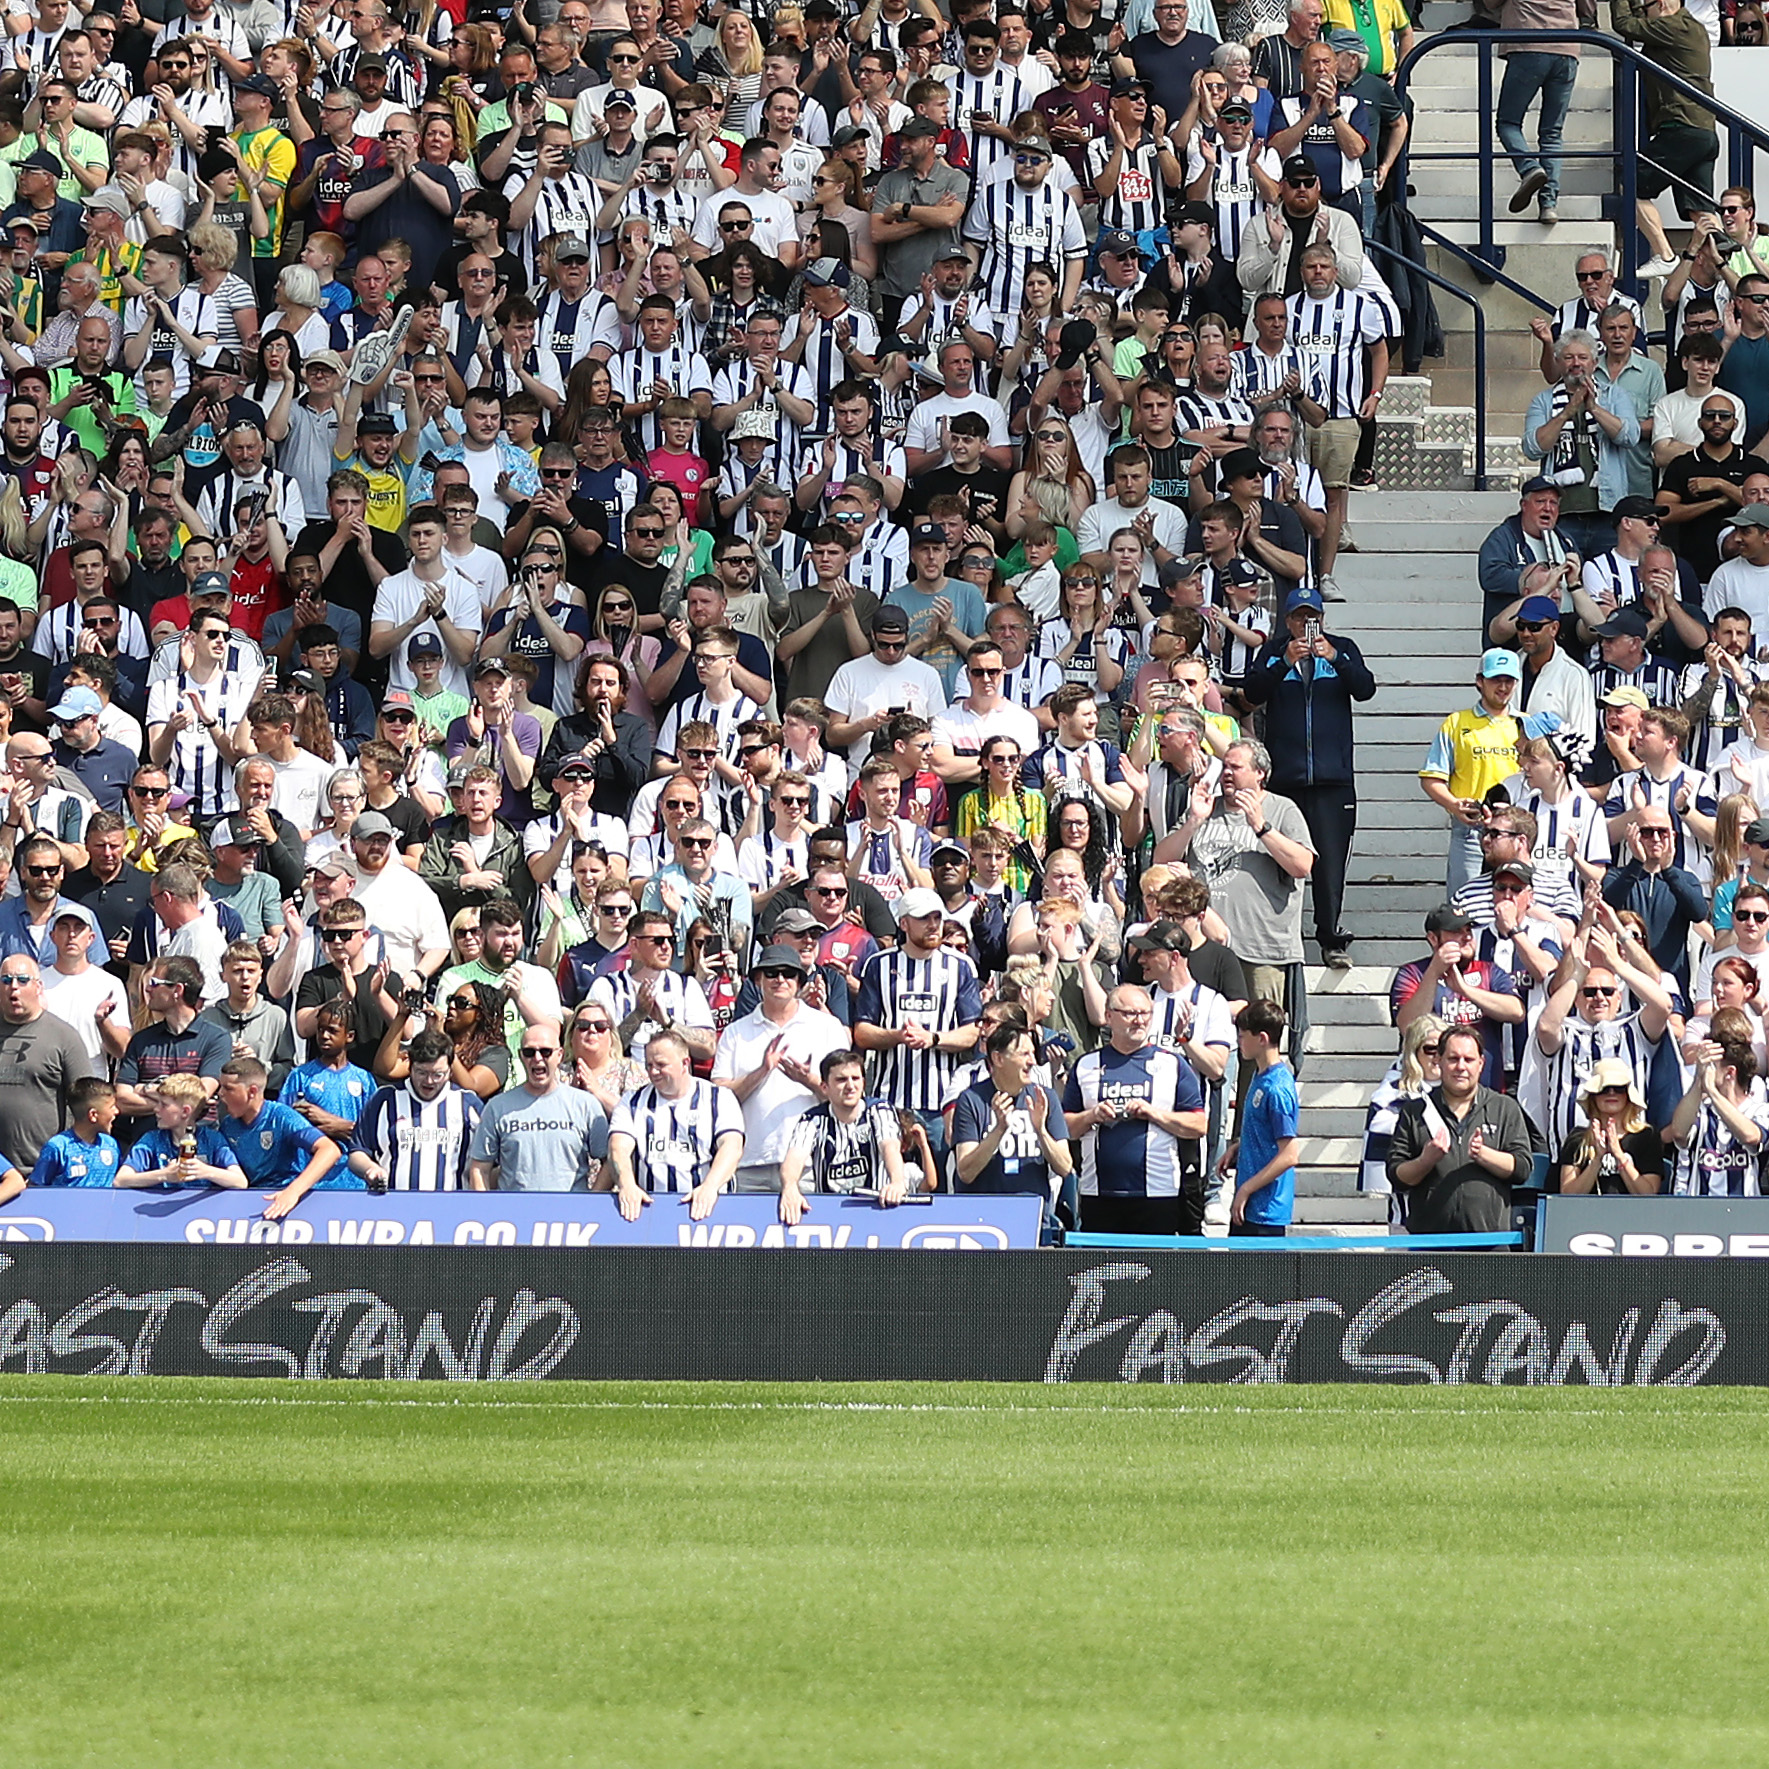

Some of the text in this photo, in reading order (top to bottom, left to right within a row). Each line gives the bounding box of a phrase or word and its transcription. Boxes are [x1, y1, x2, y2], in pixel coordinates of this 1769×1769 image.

[1123, 176, 1147, 187] 247
[1215, 180, 1253, 194] ideal
[1123, 185, 1148, 198] 999
[554, 210, 587, 223] ideal
[1012, 223, 1049, 238] ideal
[548, 332, 582, 346] ideal
[1297, 333, 1335, 346] ideal
[884, 415, 906, 427] ideal
[1066, 657, 1096, 670] ideal
[899, 998, 938, 1011] ideal
[1102, 1084, 1149, 1099] ideal
[510, 1117, 575, 1133] Barbour
[1700, 1149, 1746, 1168] Zoopla
[831, 1161, 867, 1180] ideal
[201, 1254, 582, 1381] STAND
[1341, 1266, 1728, 1386] STAND
